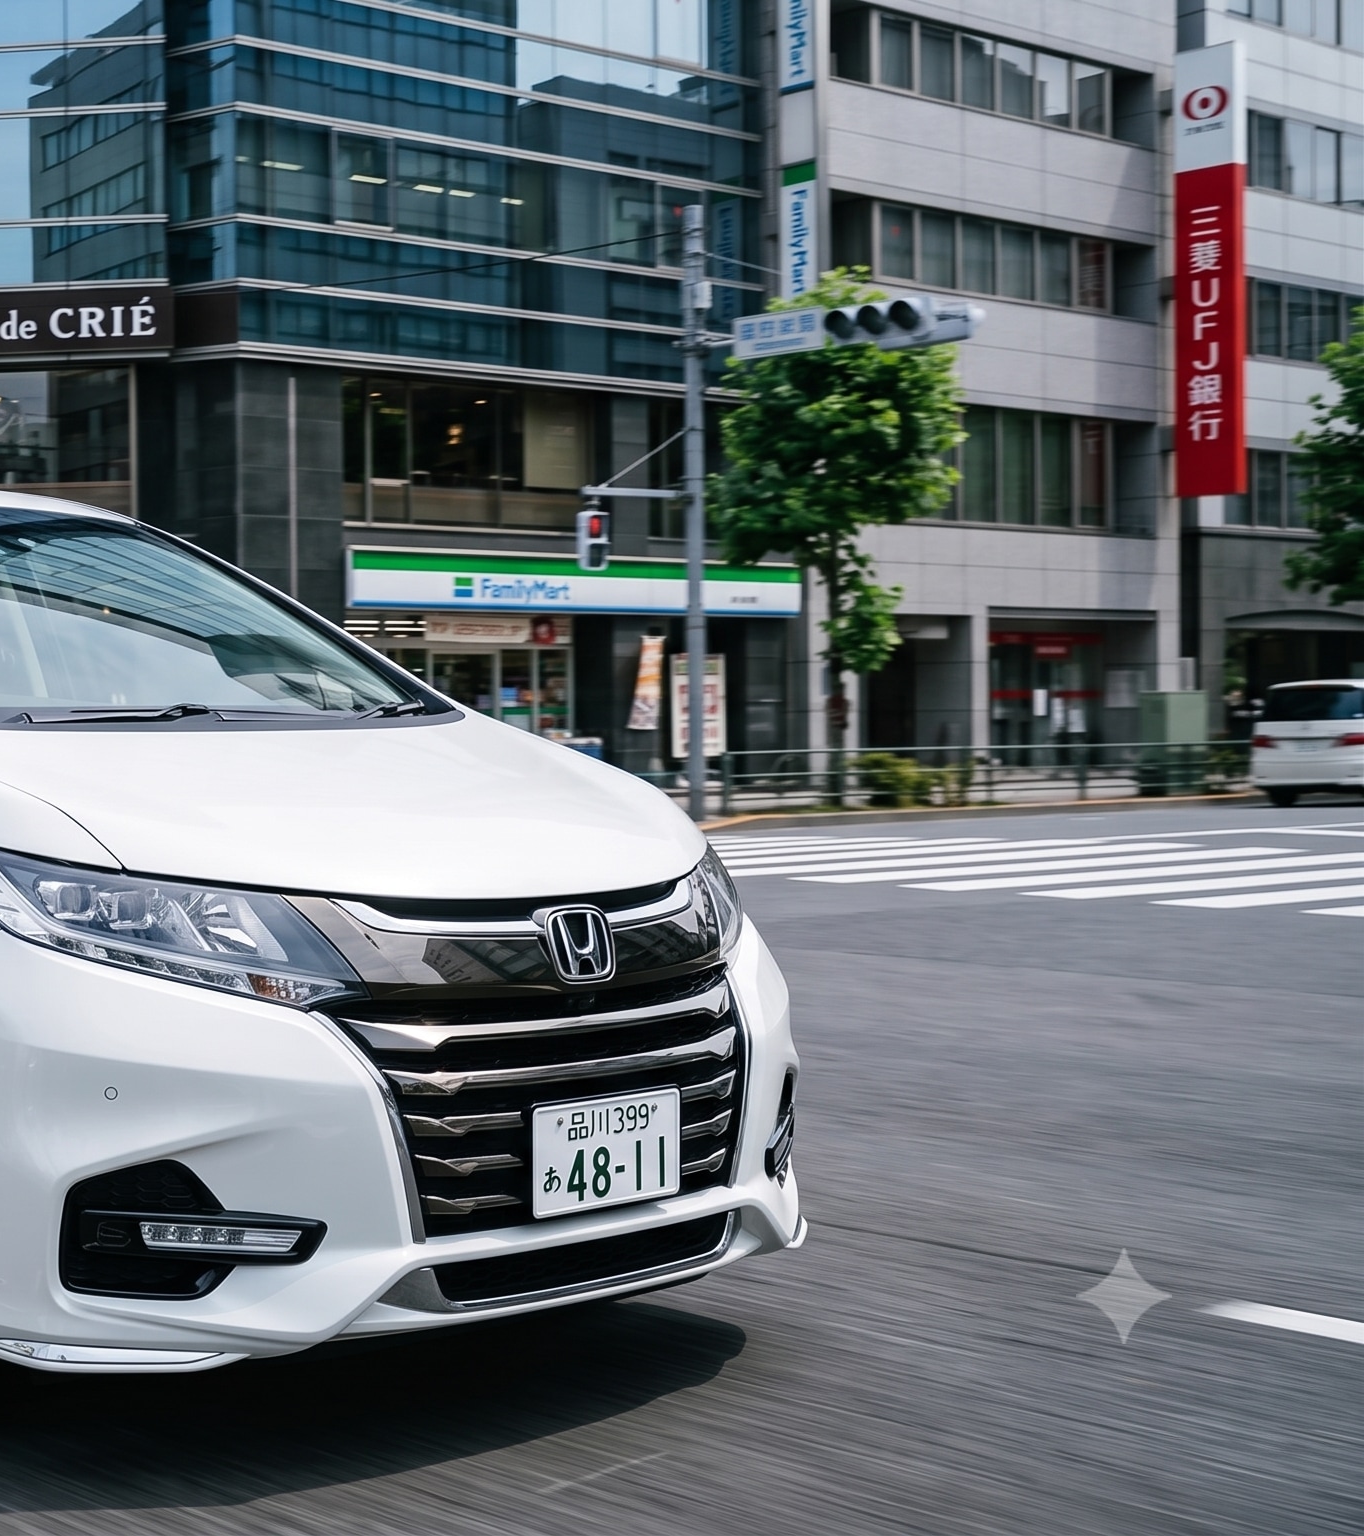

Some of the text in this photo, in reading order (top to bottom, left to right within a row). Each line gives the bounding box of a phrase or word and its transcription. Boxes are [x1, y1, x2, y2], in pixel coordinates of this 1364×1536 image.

[787, 189, 809, 295] FamilyMart
[48, 296, 157, 340] CRIÉ
[1187, 205, 1224, 442] 三菱UFJ銀行
[481, 578, 571, 603] FamilyMart
